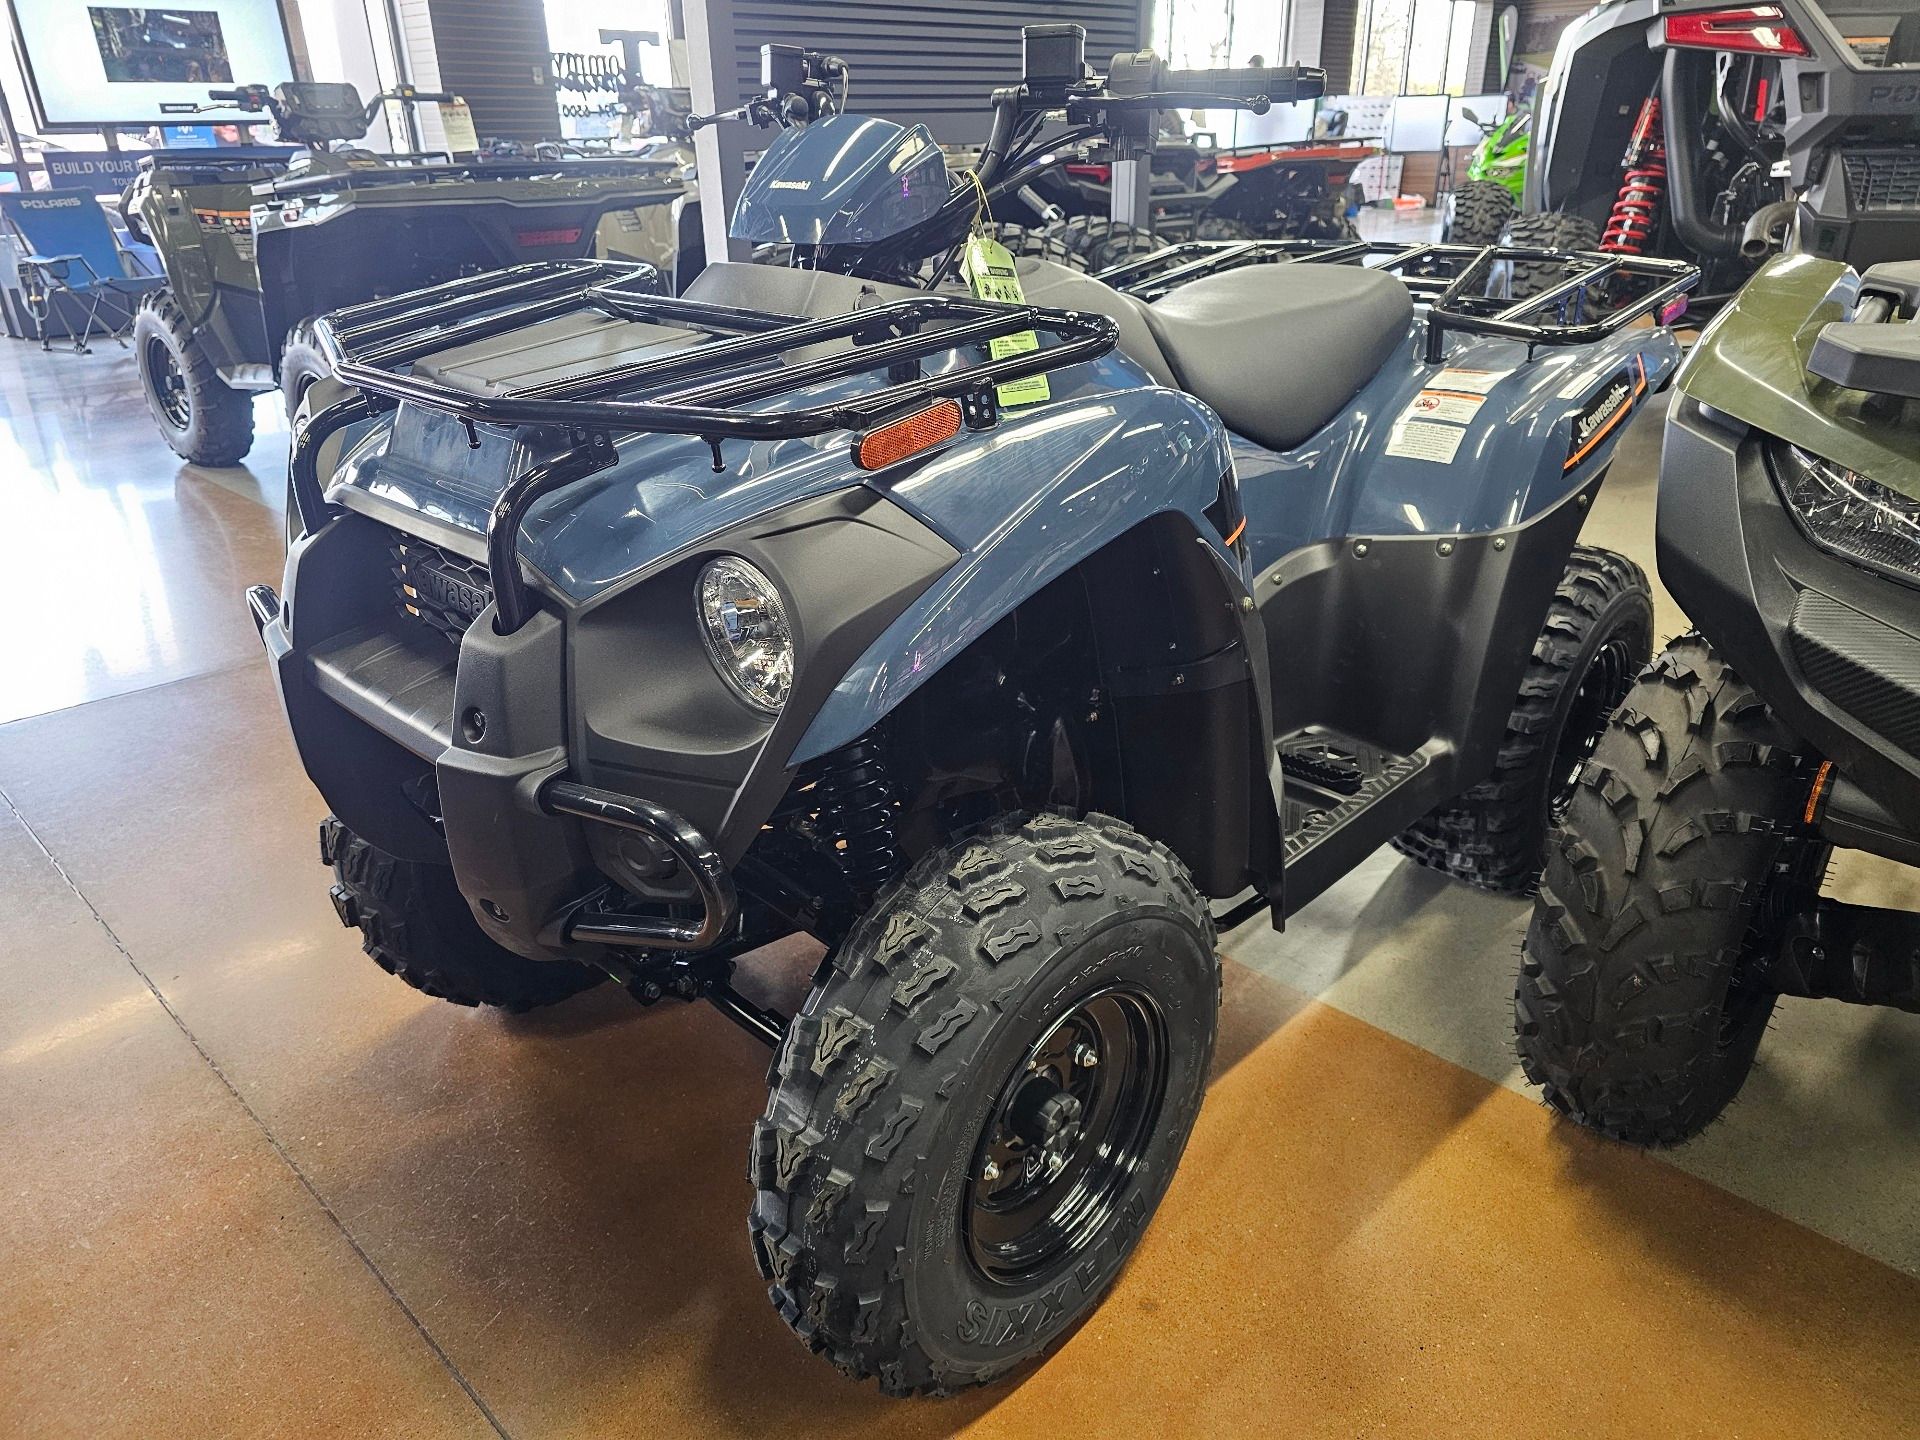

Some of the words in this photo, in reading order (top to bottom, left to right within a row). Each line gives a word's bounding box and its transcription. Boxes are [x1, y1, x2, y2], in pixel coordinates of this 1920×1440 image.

[52, 161, 94, 176] BUILD
[96, 160, 135, 174] YOUR
[769, 179, 811, 191] Kawasaki
[20, 197, 81, 210] POLARIS
[1579, 383, 1629, 437] Kawasaki
[957, 1188, 1147, 1344] MAXXIS
